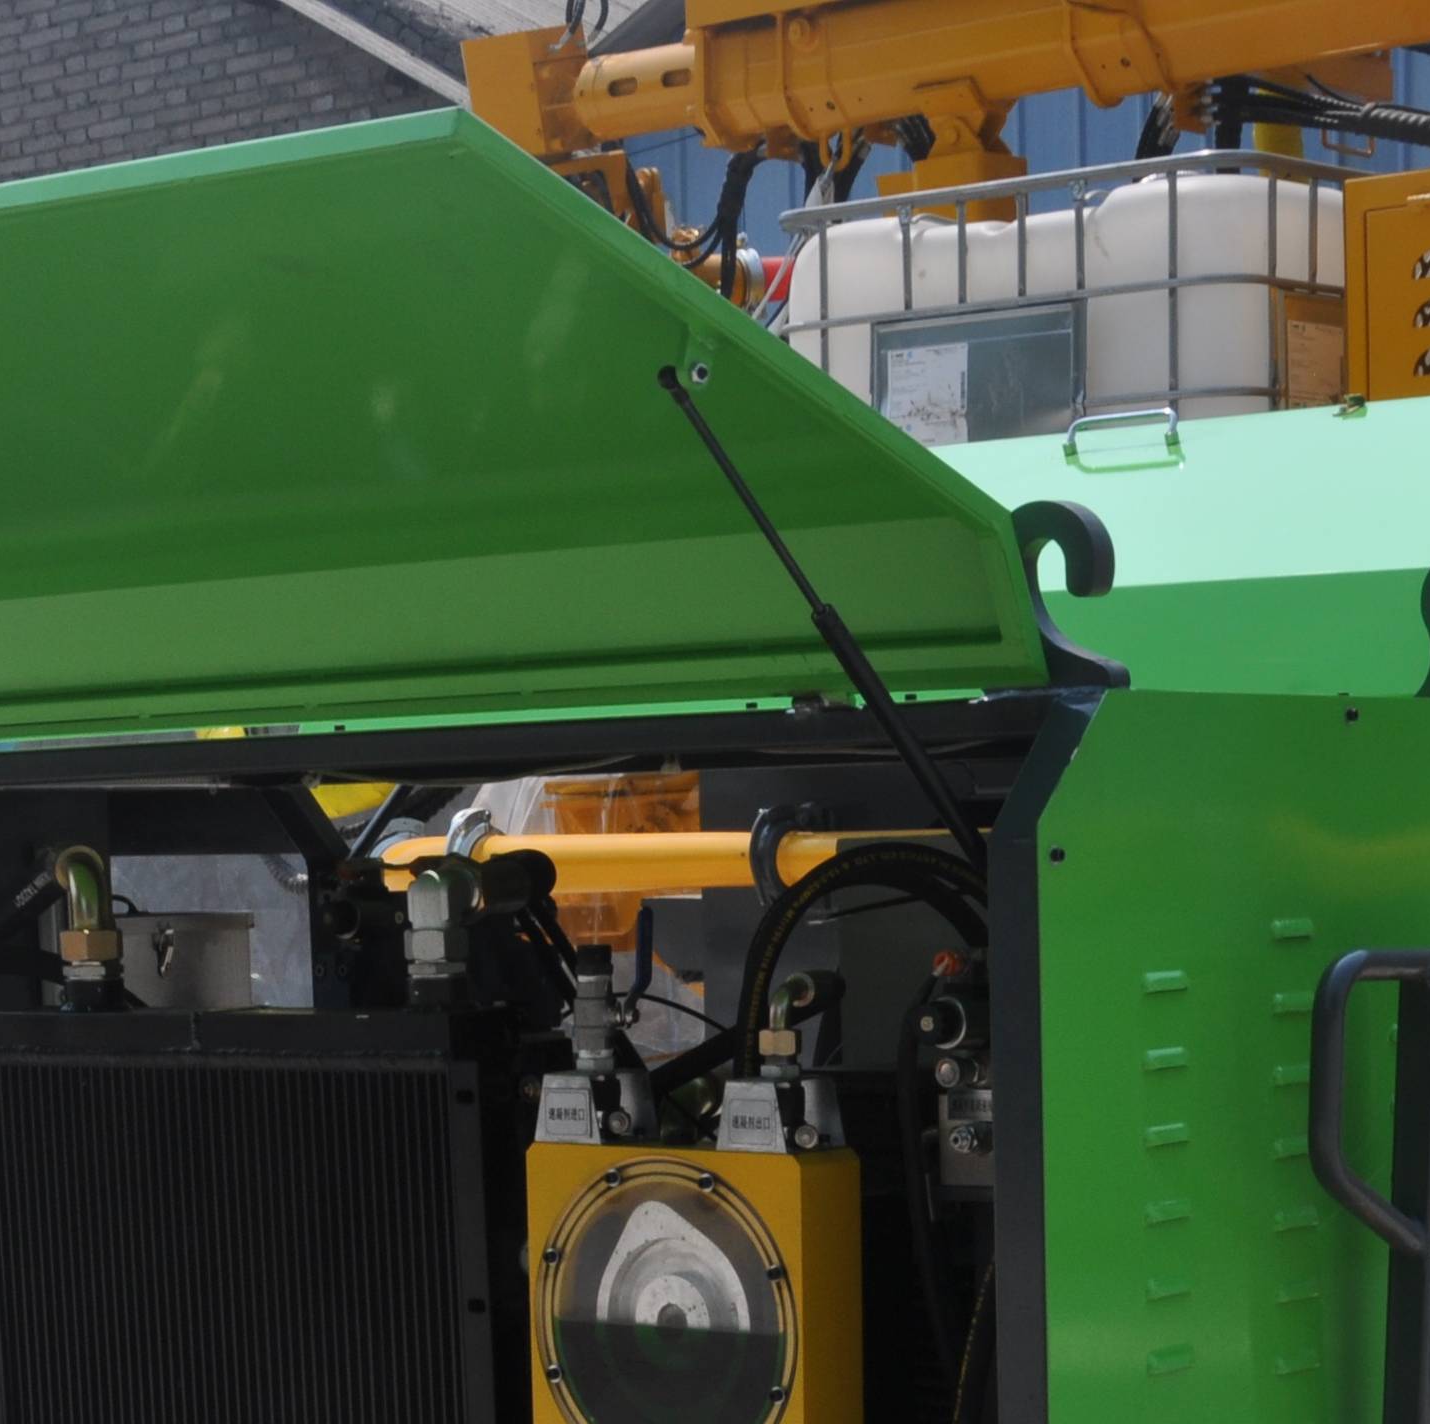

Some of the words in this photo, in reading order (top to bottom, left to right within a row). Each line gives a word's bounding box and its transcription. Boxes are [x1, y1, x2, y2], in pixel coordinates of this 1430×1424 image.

[548, 1107, 585, 1121] 速凝剂进口
[732, 1115, 770, 1130] 速凝剂出口
